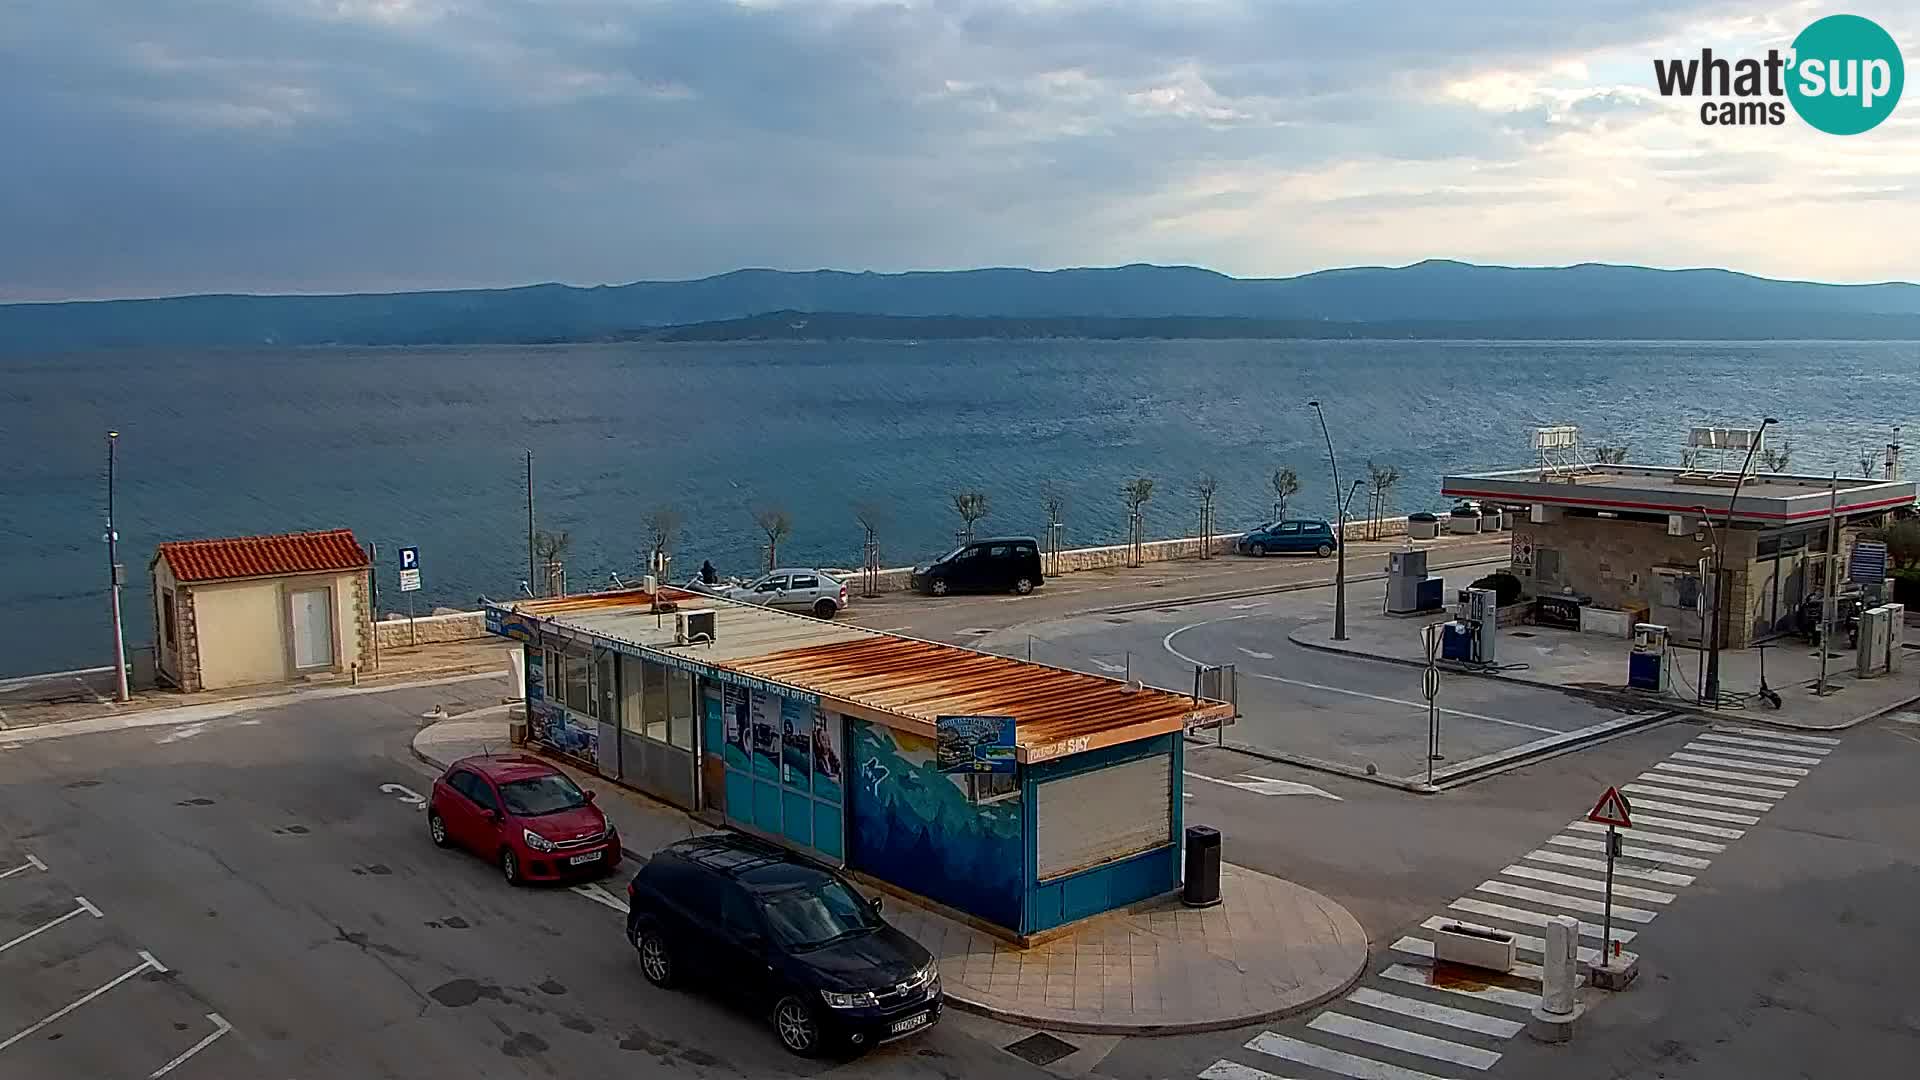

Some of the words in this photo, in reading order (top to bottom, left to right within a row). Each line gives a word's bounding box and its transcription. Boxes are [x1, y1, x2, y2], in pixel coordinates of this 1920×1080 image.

[402, 550, 415, 568] P
[718, 671, 732, 681] BUS
[733, 674, 763, 691] STATION
[765, 683, 790, 697] TICKET
[791, 690, 817, 704] OFFICE
